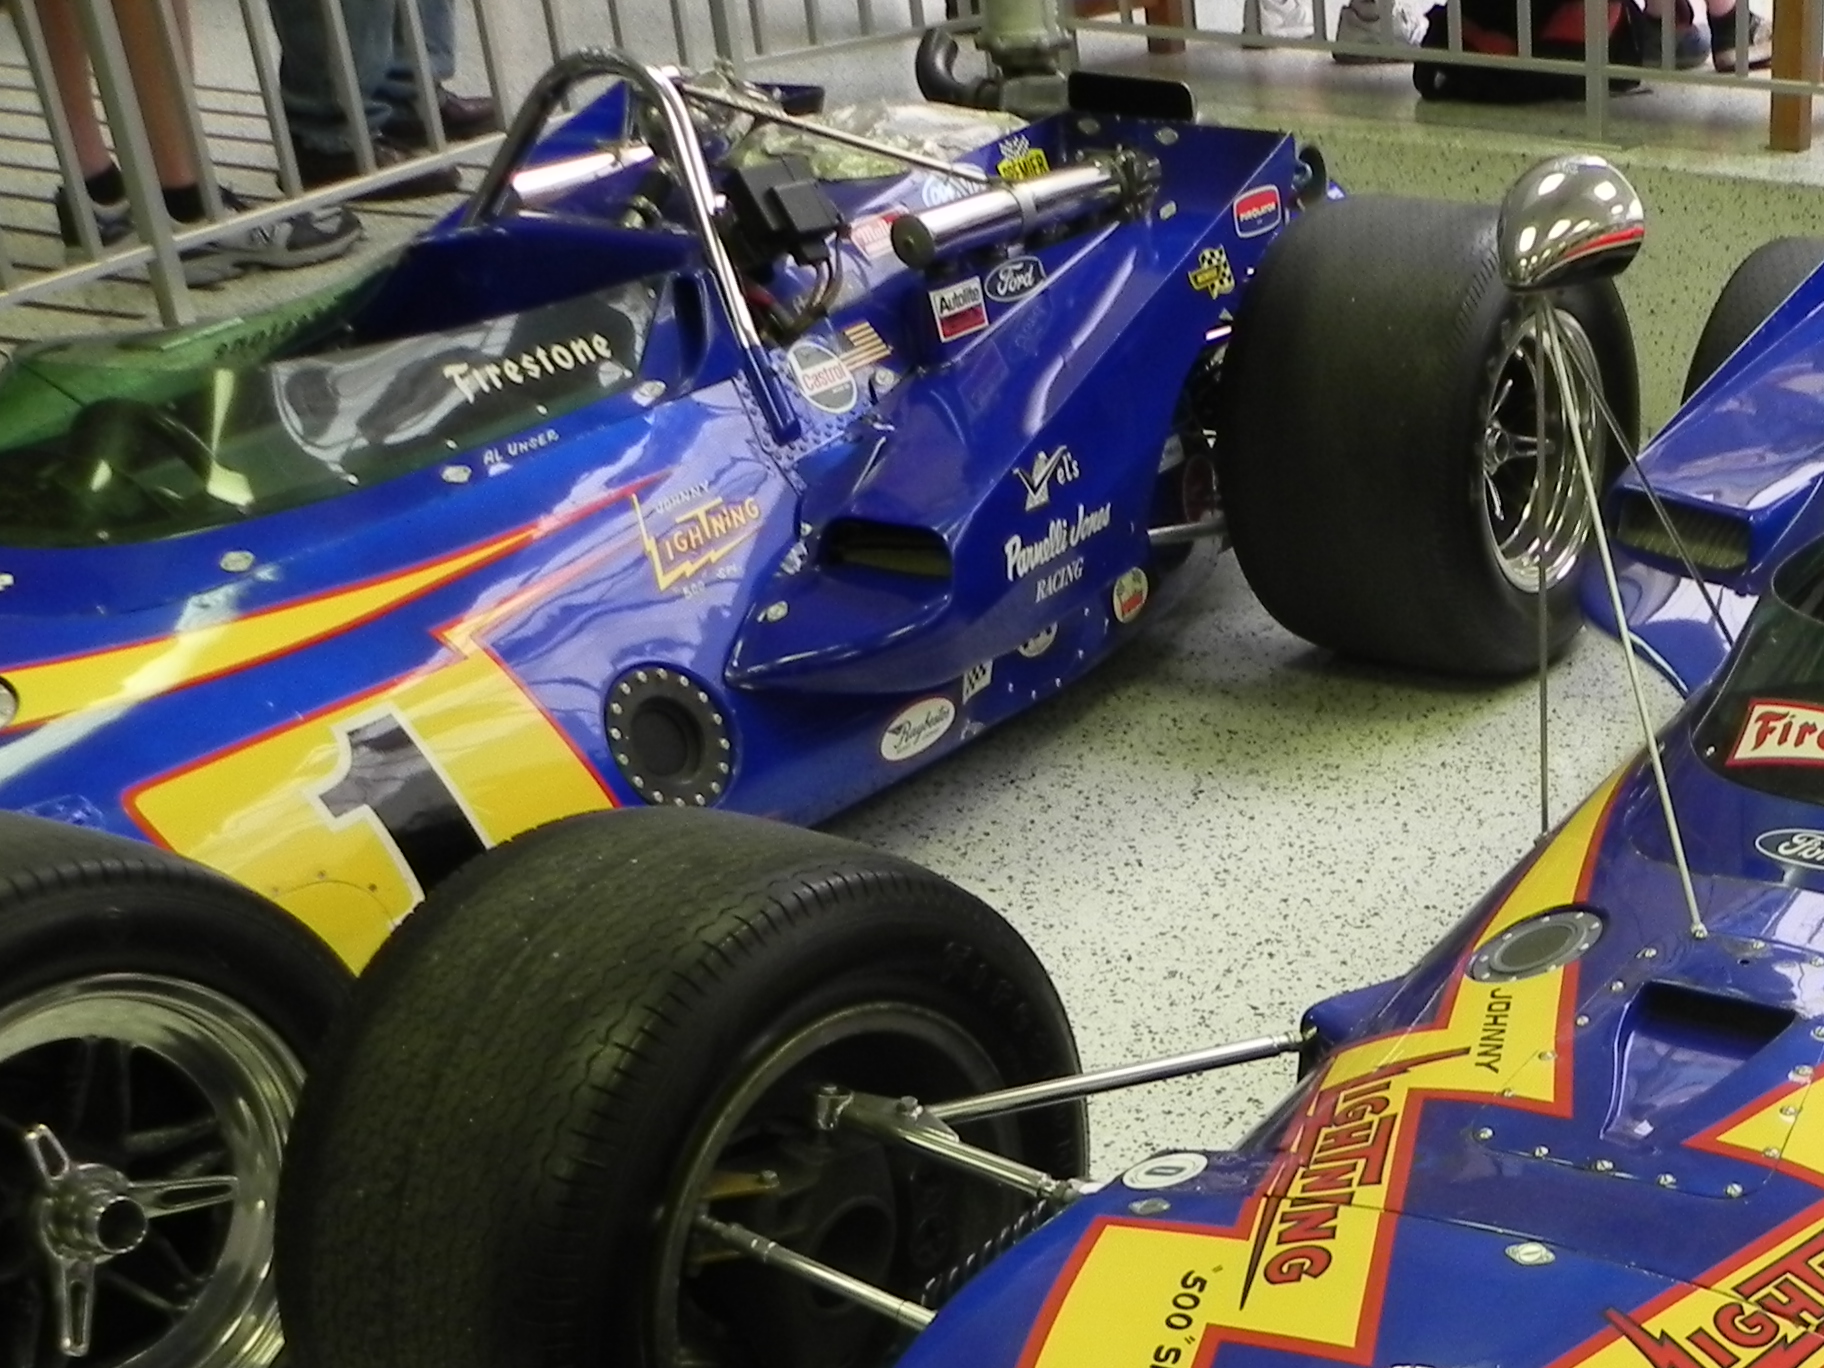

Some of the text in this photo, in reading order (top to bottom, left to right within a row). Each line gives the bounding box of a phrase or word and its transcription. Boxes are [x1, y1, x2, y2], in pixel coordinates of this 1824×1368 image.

[938, 284, 982, 315] Autolite
[996, 262, 1036, 296] Ford
[443, 332, 612, 404] Firestone
[801, 362, 847, 392] Castrol
[483, 428, 561, 466] AL UNSER
[631, 492, 762, 593] LIGHTNING
[1004, 501, 1112, 583] Parnelli Jones
[1035, 556, 1085, 604] RACING
[310, 704, 492, 926] 1
[1474, 986, 1513, 1075] JOHNNY
[1239, 1046, 1473, 1312] LIGHTNING
